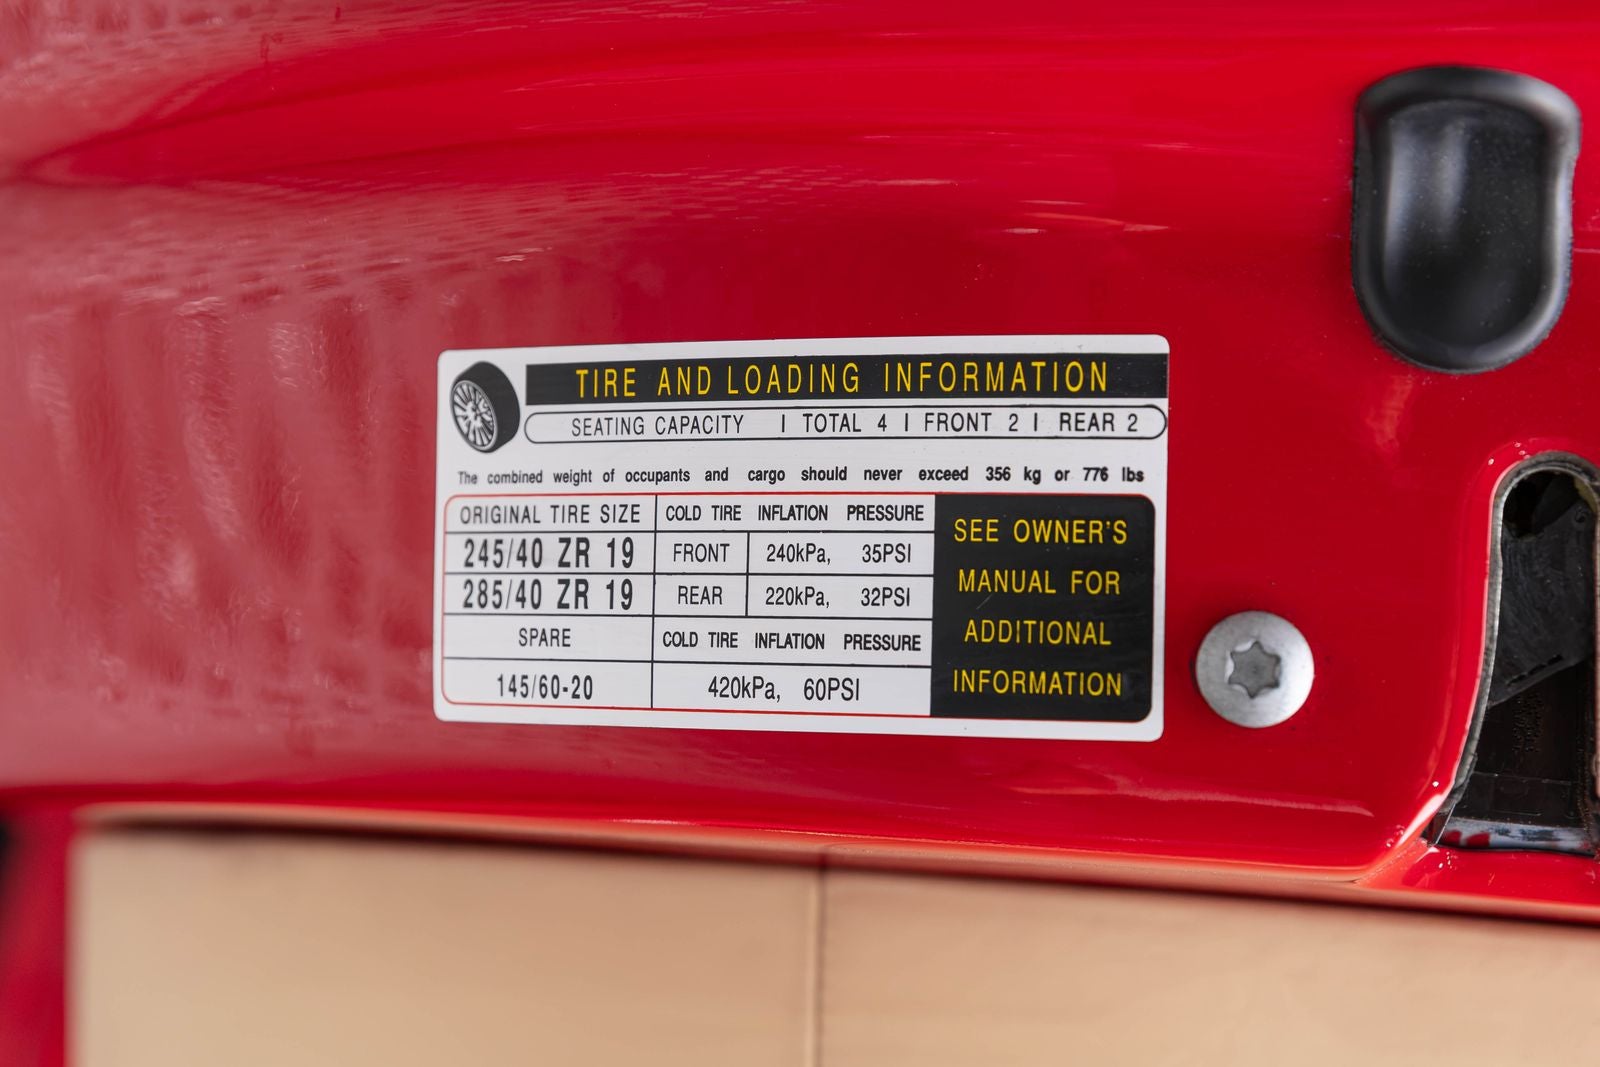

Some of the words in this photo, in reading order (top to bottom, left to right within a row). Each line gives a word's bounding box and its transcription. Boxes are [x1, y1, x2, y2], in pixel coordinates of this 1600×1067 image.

[576, 367, 636, 399] TIRE
[657, 365, 712, 397] AND
[727, 362, 859, 395] LOADING
[885, 361, 1108, 393] INFORMATION
[571, 416, 645, 437] SEATING
[655, 414, 744, 435] CAPACITY
[803, 412, 862, 433] TOTAL
[877, 413, 887, 432] 4
[924, 412, 992, 432] FRONT
[1008, 413, 1019, 432] 2
[1059, 412, 1115, 432] REAR
[1127, 414, 1138, 432] 2
[457, 471, 478, 485] The
[487, 470, 543, 484] combined
[553, 469, 593, 486] weight
[603, 468, 615, 483] of
[625, 468, 691, 485] occupants
[704, 467, 729, 482] and
[747, 469, 786, 485] cargo
[800, 466, 848, 482] should
[864, 468, 903, 481] never
[918, 466, 969, 481] exceed
[985, 466, 1011, 482] 356
[1024, 466, 1042, 485] kg
[1054, 469, 1070, 482] or
[1083, 467, 1109, 482] 776
[1122, 467, 1144, 482] lbs
[460, 505, 541, 525] ORIGINAL
[550, 504, 590, 523] TIRE
[600, 504, 641, 523] SIZE
[665, 505, 702, 522] COLD
[711, 505, 742, 521] TIRE
[758, 505, 828, 521] INFLATION
[847, 505, 924, 522] PRESSURE
[954, 519, 999, 542] SEE
[1013, 519, 1127, 545] OWNER'S
[464, 537, 543, 569] 245/40
[557, 537, 591, 569] ZR
[606, 537, 634, 569] 19
[672, 543, 730, 563] FRONT
[766, 543, 831, 566] 240kPa,
[861, 543, 912, 563] 35PSI
[462, 579, 542, 610] 285/40
[557, 578, 590, 610] ZR
[606, 578, 633, 610] 19
[958, 569, 1056, 594] MANUAL
[1071, 570, 1120, 595] FOR
[677, 585, 723, 605] REAR
[765, 587, 830, 609] 220kPa,
[860, 587, 910, 608] 32PSI
[518, 628, 571, 648] SPARE
[662, 631, 698, 648] COLD
[708, 631, 738, 648] TIRE
[755, 633, 825, 650] INFLATION
[843, 634, 921, 652] PRESSURE
[964, 619, 1112, 646] ADDITIONAL
[497, 674, 593, 700] 145/60-20
[708, 676, 781, 702] 420kPa,
[803, 677, 860, 701] 60PSI
[953, 669, 1121, 696] INFORMATION
